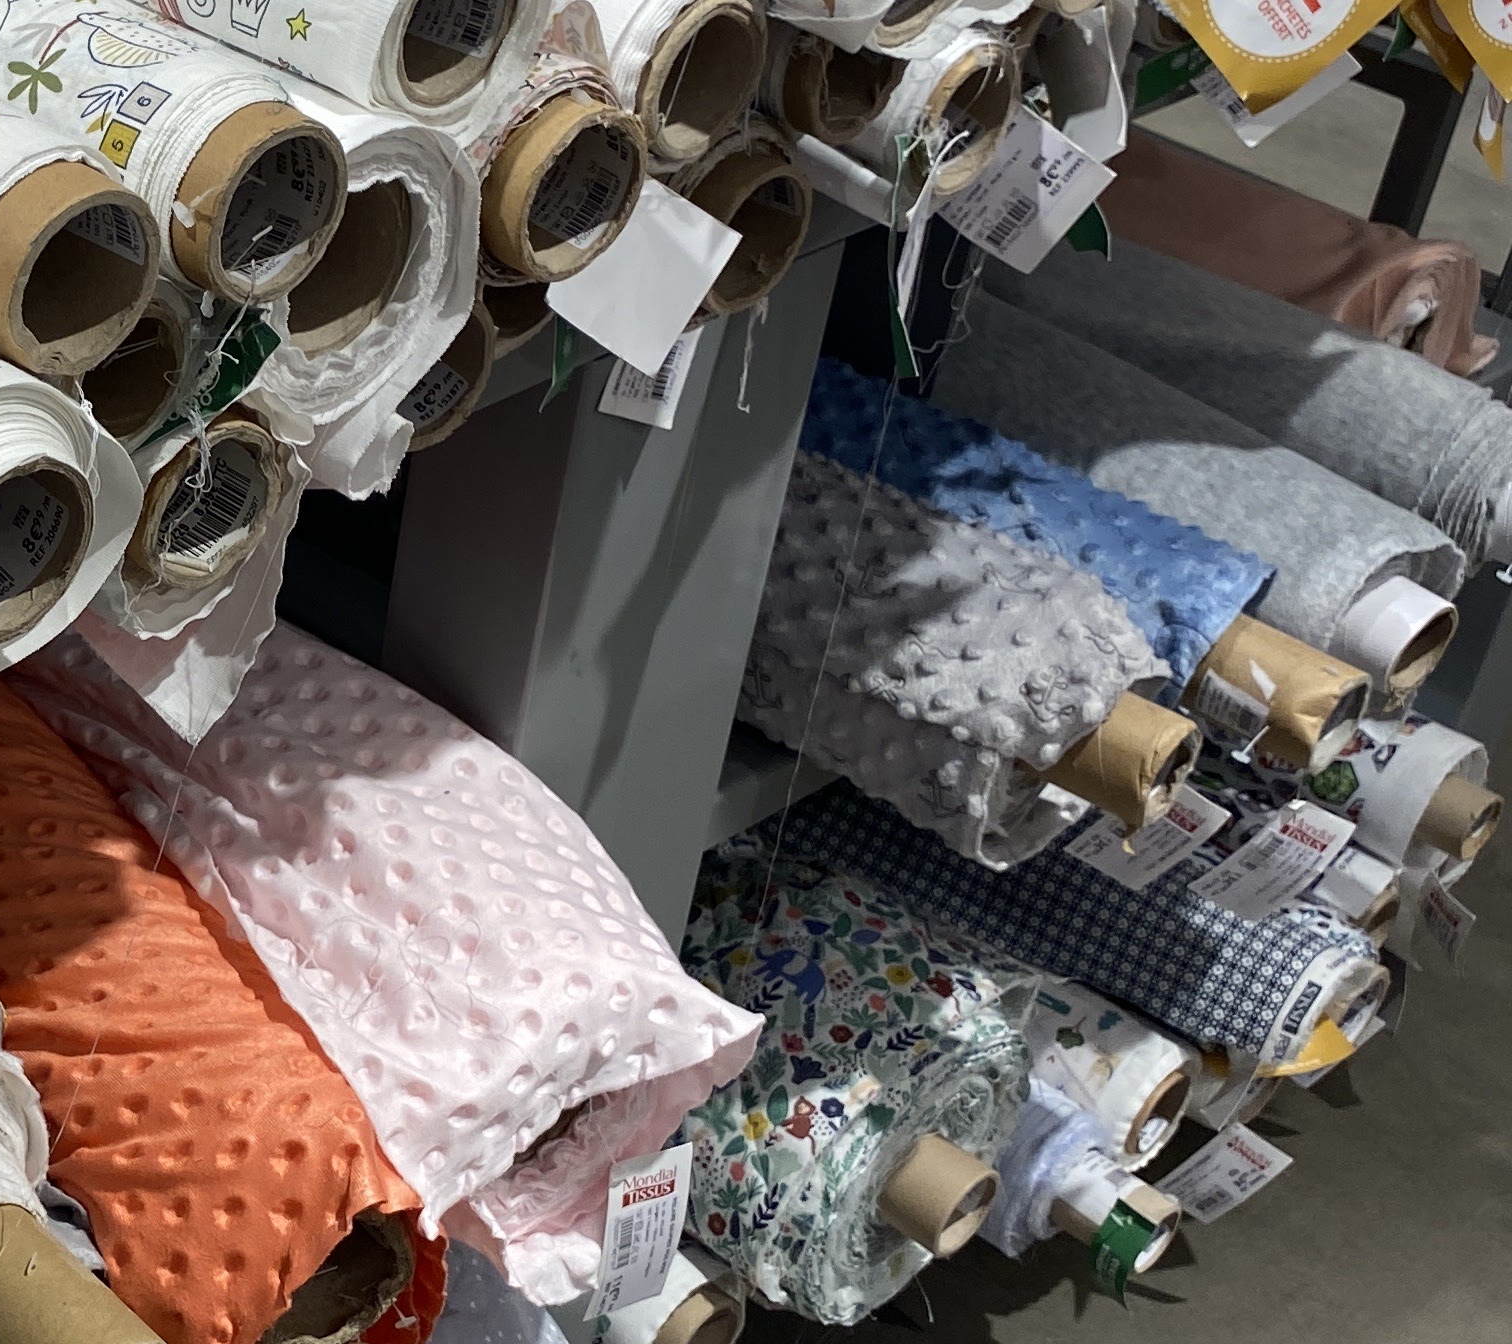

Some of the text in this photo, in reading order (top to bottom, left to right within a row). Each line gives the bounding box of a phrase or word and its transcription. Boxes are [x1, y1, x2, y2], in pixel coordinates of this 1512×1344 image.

[1258, 0, 1294, 41] OFFERT
[16, 509, 53, 555] 8€99
[28, 544, 47, 567] REF
[623, 1166, 677, 1192] Mondial
[627, 1183, 672, 1205] TISSUS
